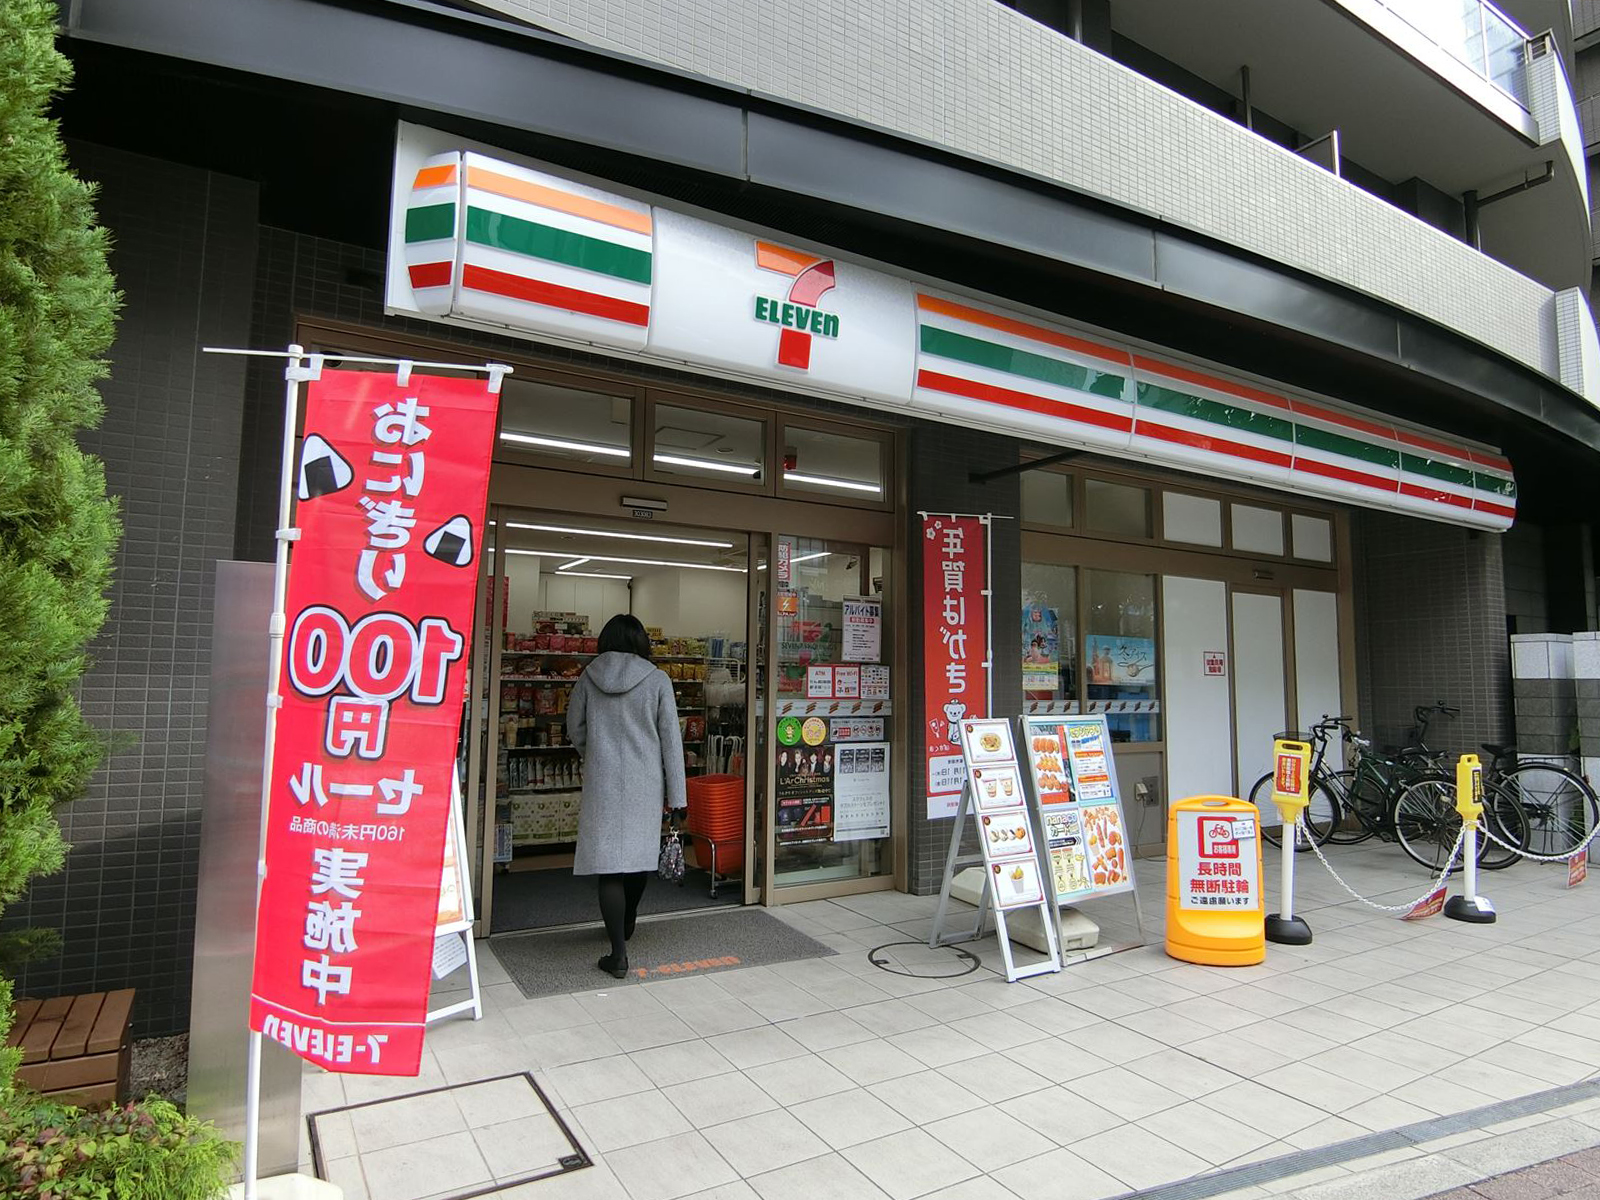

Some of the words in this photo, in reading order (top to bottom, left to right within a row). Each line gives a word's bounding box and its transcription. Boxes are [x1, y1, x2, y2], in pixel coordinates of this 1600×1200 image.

[756, 240, 836, 370] 7
[844, 604, 879, 617] アルバイト募集
[780, 776, 829, 785] L'ArChristmas
[1046, 813, 1077, 826] nanaco
[1197, 862, 1242, 876] 長時間
[1190, 879, 1249, 894] 無断駐輪
[1191, 896, 1250, 905] ご遠慮願います
